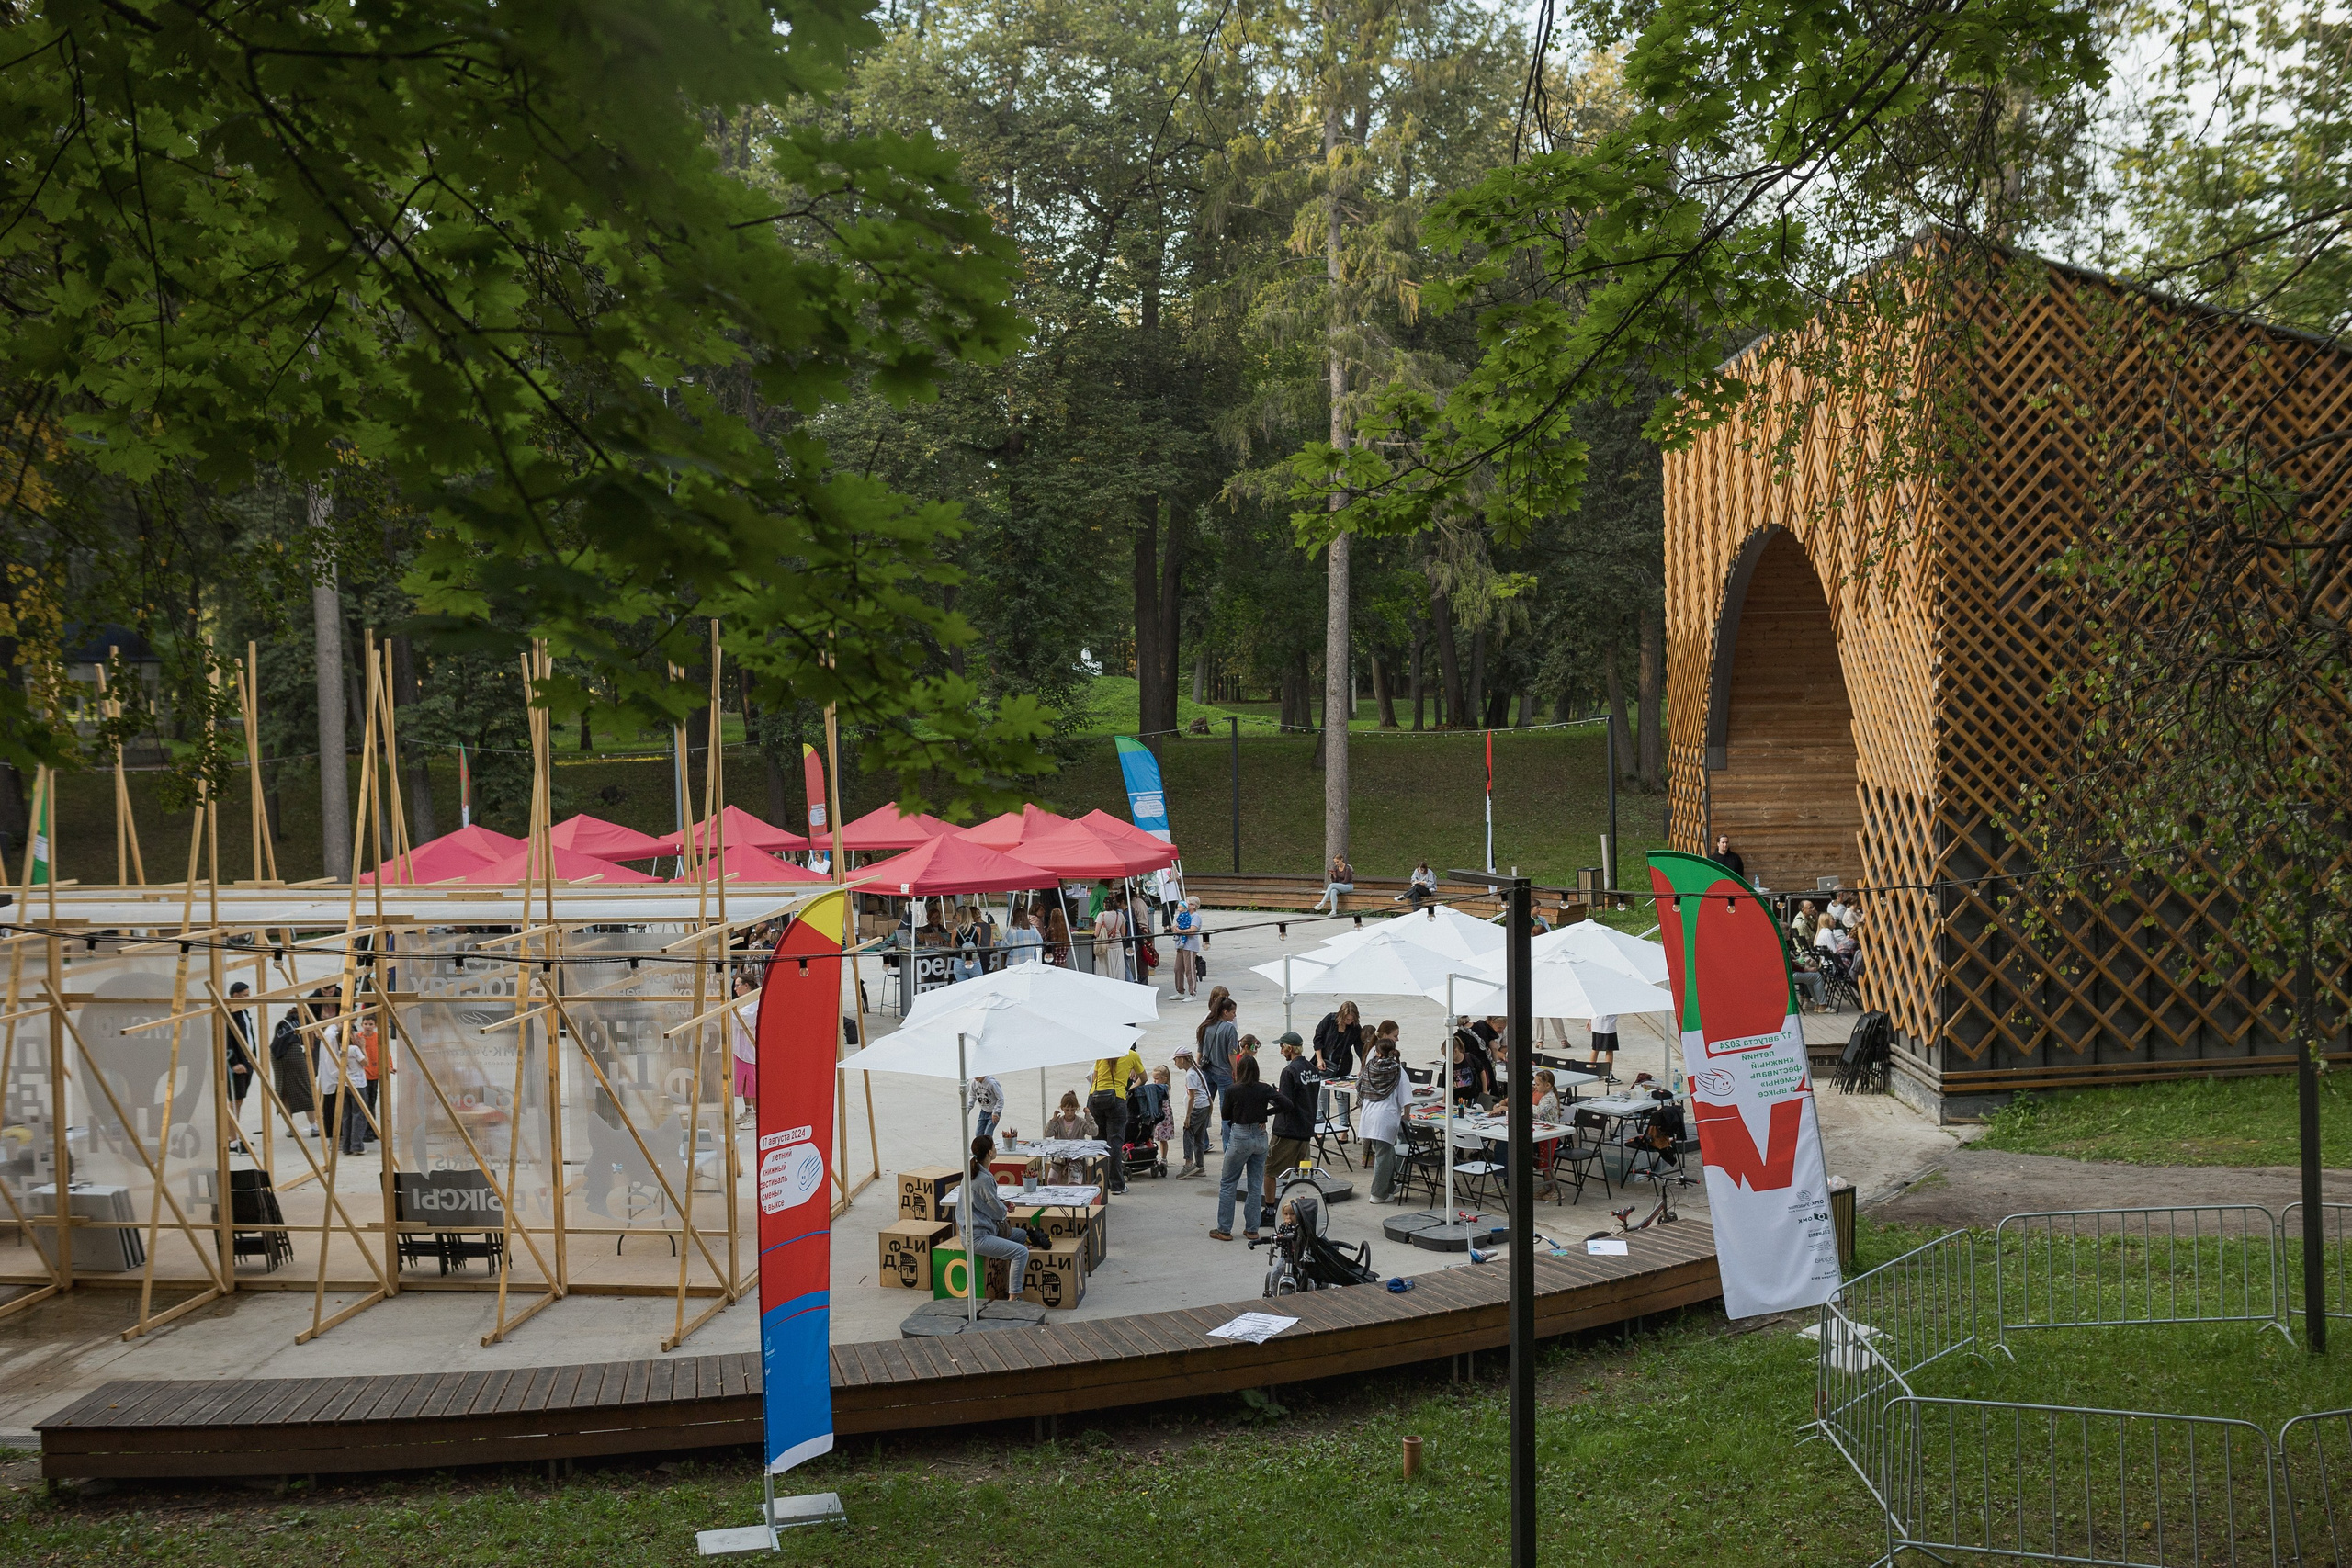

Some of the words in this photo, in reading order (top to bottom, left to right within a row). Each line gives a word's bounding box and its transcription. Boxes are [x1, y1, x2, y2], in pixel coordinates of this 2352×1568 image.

[762, 1138, 768, 1147] 17
[768, 1134, 791, 1145] августа
[791, 1128, 806, 1140] 2024
[771, 1149, 793, 1162] летний
[762, 1162, 787, 1177] книжный
[768, 1199, 785, 1212] выксе
